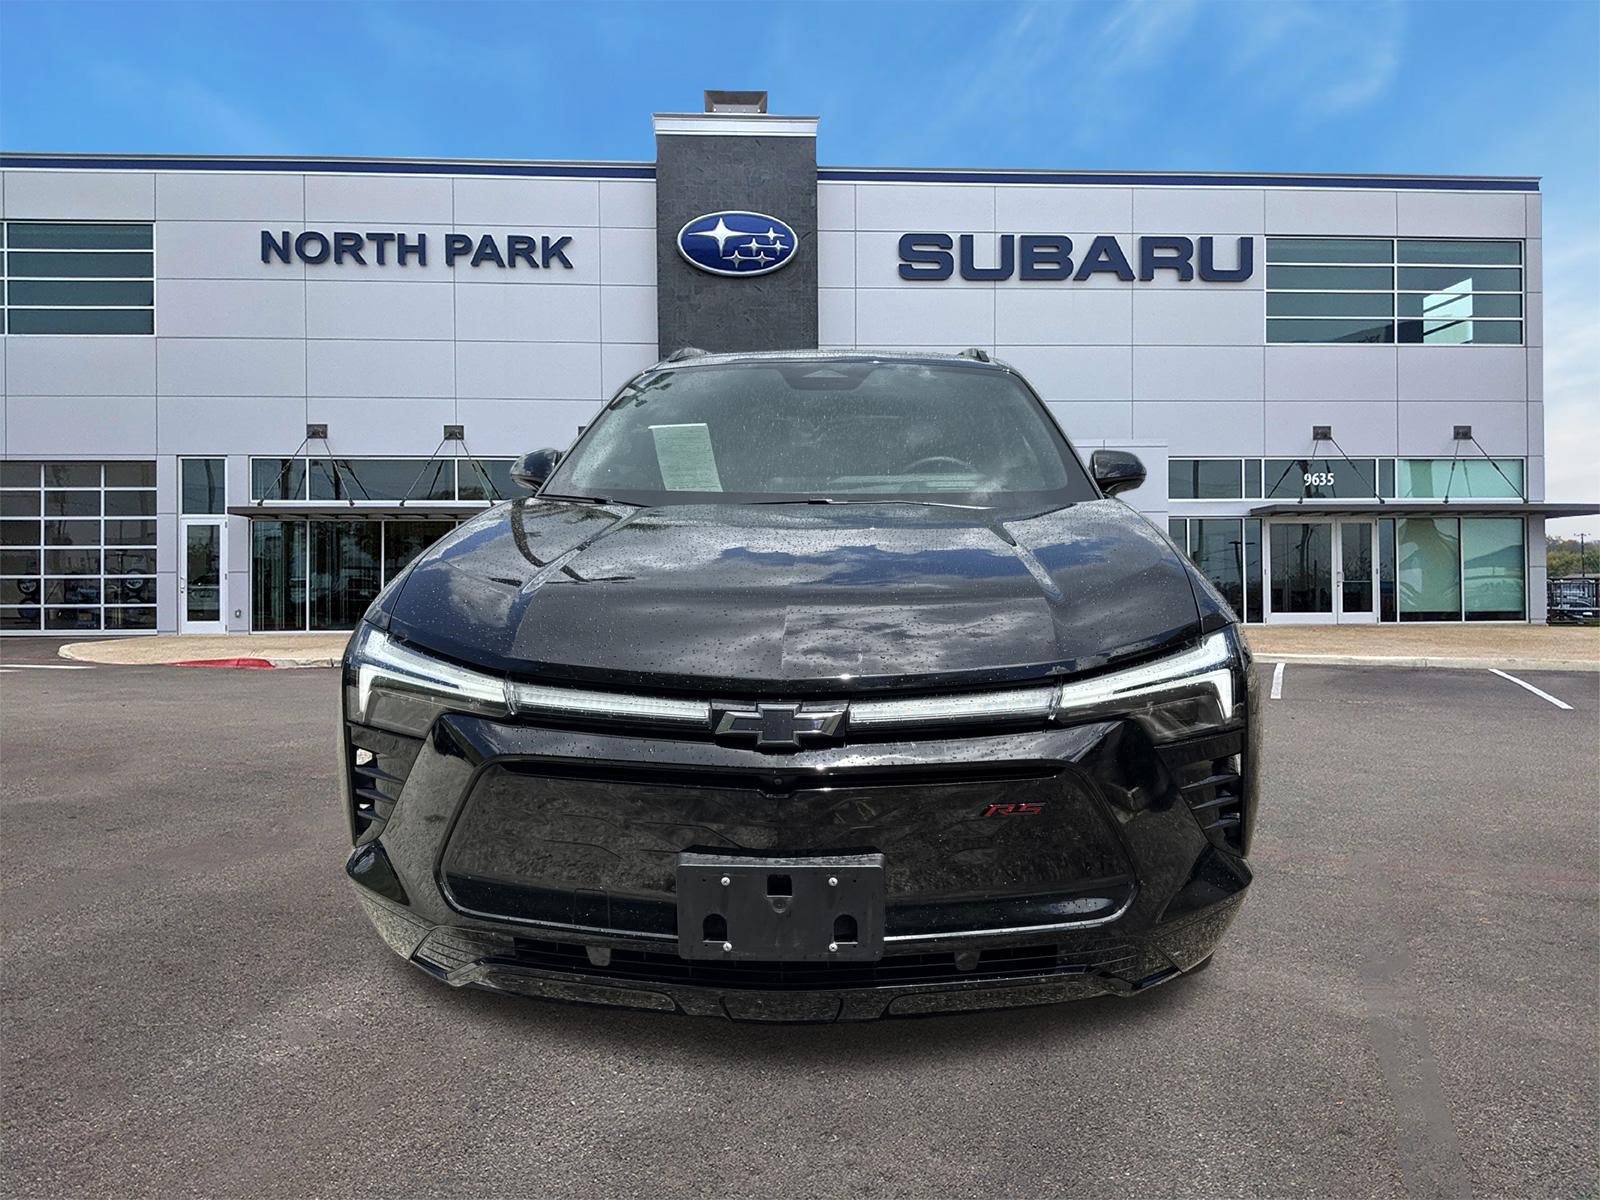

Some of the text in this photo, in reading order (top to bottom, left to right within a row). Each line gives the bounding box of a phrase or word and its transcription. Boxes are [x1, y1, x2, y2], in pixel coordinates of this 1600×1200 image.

[260, 230, 574, 270] NORTH PARK
[898, 232, 1254, 283] SUBARU
[1303, 472, 1335, 486] 9635
[981, 802, 1044, 817] RS
